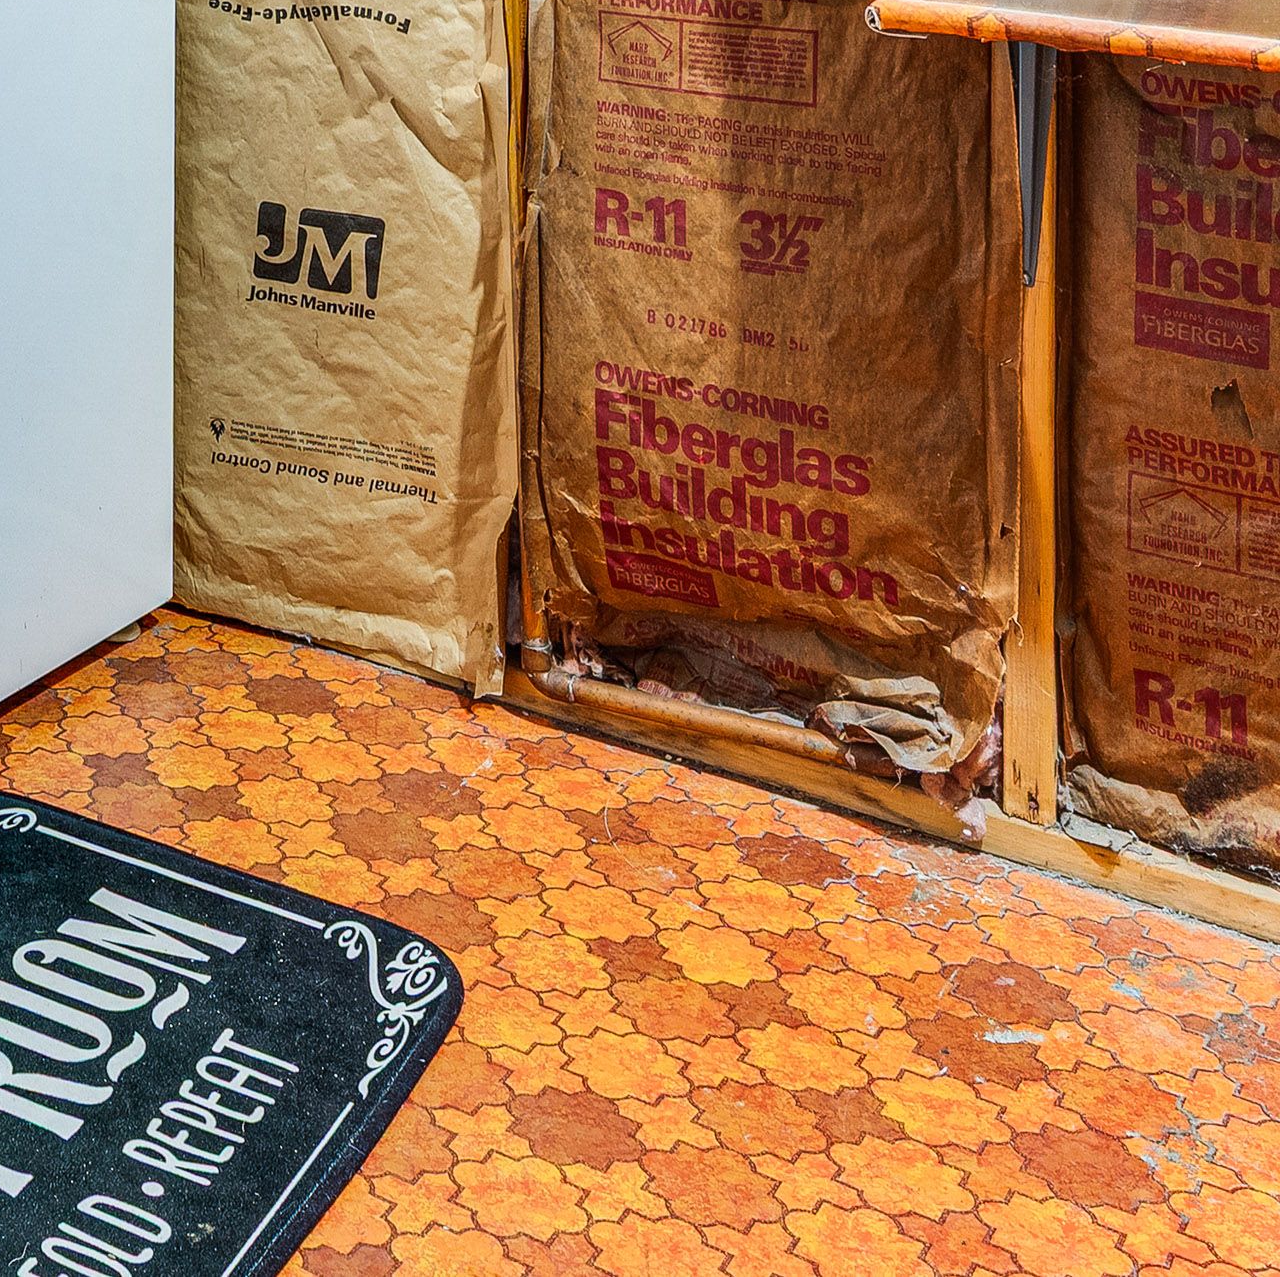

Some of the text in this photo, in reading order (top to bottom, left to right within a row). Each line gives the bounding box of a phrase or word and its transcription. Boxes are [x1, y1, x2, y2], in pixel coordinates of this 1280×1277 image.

[598, 101, 872, 146] WARNING: FACING on this insulation WILL
[629, 120, 652, 133] AND
[656, 123, 700, 140] SHOULD
[704, 132, 728, 142] NOT
[732, 135, 746, 146] BE
[750, 136, 776, 150] LEFT
[845, 148, 886, 162] Special
[596, 144, 614, 154] with
[618, 148, 630, 156] an
[596, 131, 881, 177] care should be taken when working close to the facing
[594, 162, 765, 196] Unfaced building insulation is
[594, 187, 687, 247] R-11
[253, 201, 385, 299] JM
[594, 236, 693, 262] INSULATION ONLY
[246, 286, 375, 319] Johns Manville
[665, 312, 727, 338] 021786
[1142, 315, 1260, 354] FIBERGLAS
[594, 360, 830, 430] OWENS-CORNING
[1125, 424, 1255, 468] ASSURED
[211, 451, 438, 504] Thermal and Sound Control
[596, 444, 849, 558] Building
[600, 499, 899, 607] Insulation
[614, 567, 711, 600] FIBERGLAS
[1128, 573, 1223, 607] WARNING:
[1128, 590, 1265, 630] BURN AND SHOULD
[1128, 607, 1257, 644] care should be taken
[1128, 621, 1253, 659] with an open flame.
[1133, 667, 1248, 746] R-11
[1135, 718, 1217, 754] INSULATION
[122, 1028, 299, 1186] REPEAT
